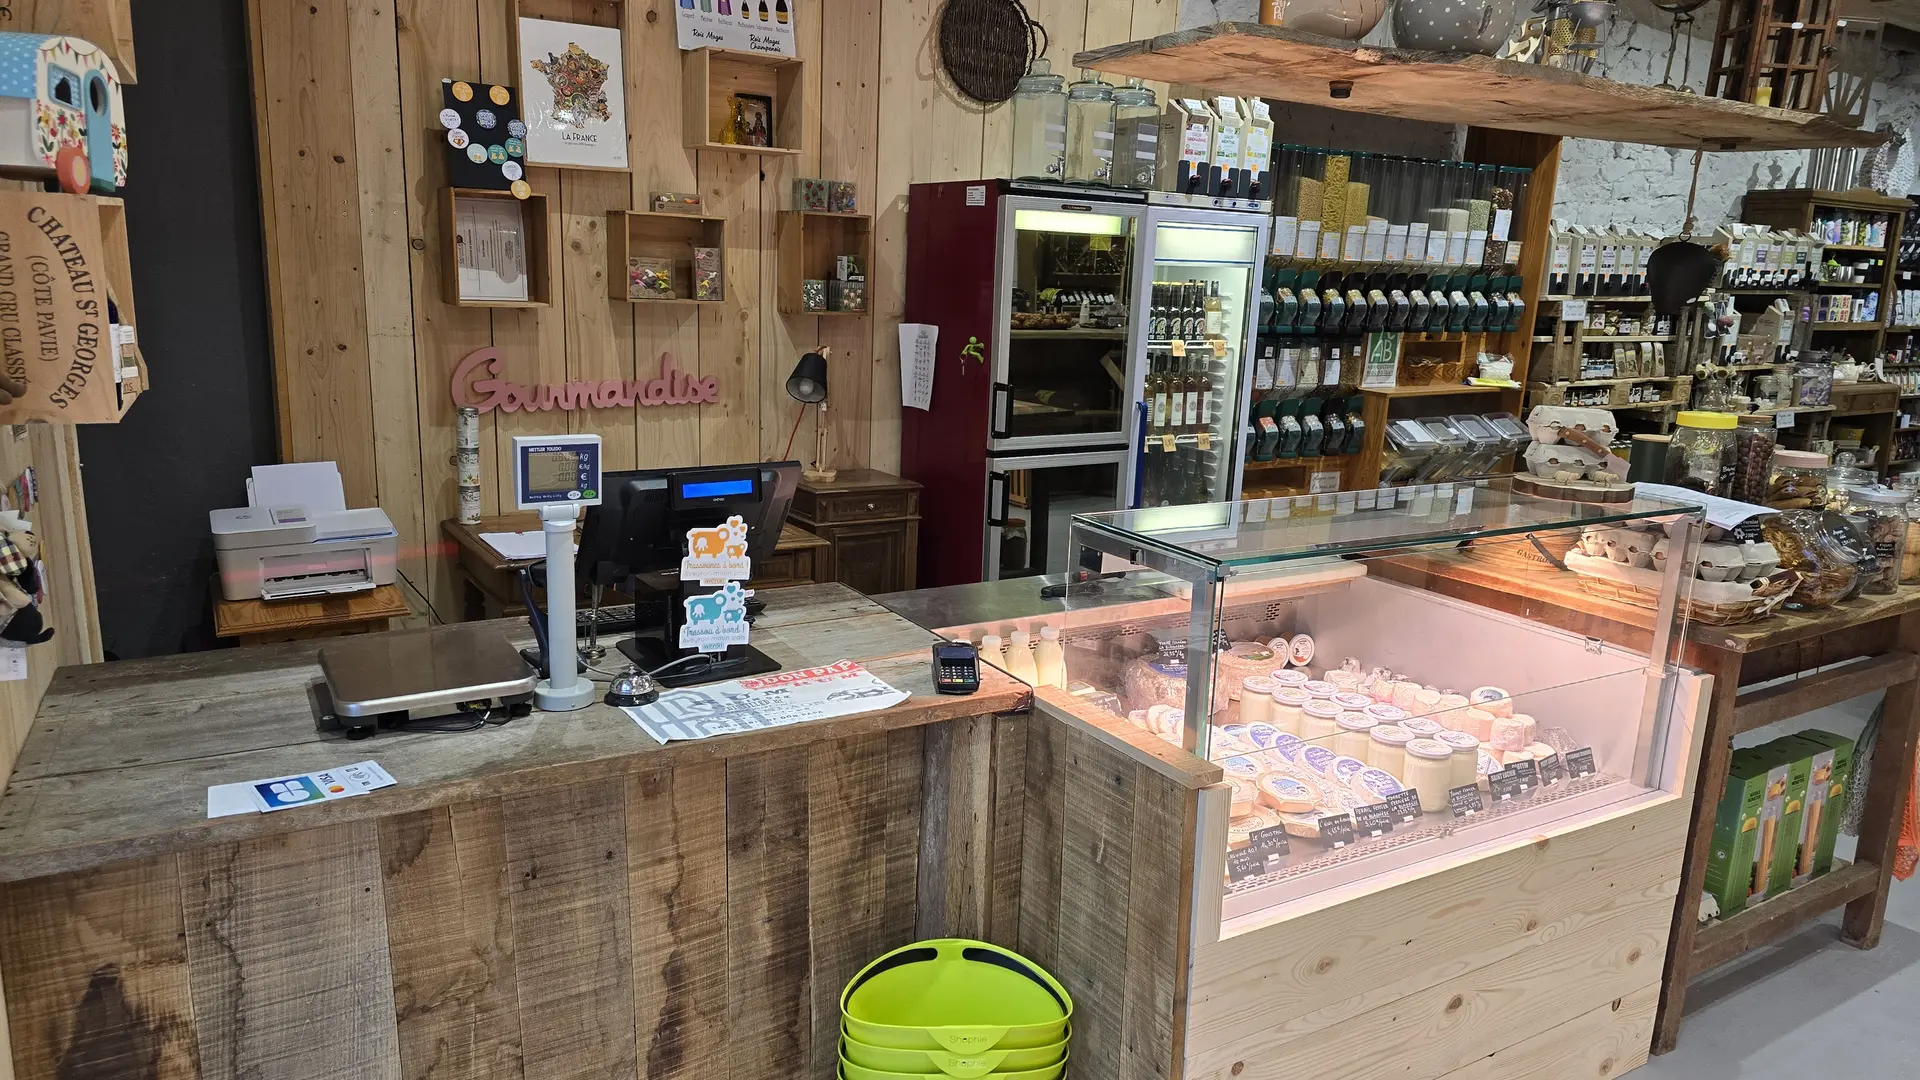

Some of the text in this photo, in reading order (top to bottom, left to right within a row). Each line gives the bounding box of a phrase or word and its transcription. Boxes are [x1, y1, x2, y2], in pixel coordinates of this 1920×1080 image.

[562, 132, 597, 143] LA FRANCE
[26, 206, 95, 294] CHATEAU
[1, 291, 20, 323] CRU
[36, 311, 60, 362] PAVIE)
[1370, 339, 1392, 362] AB
[49, 322, 100, 410] GEORGES
[452, 346, 720, 414] Gourmandise
[580, 453, 589, 461] kg
[761, 672, 806, 686] DON
